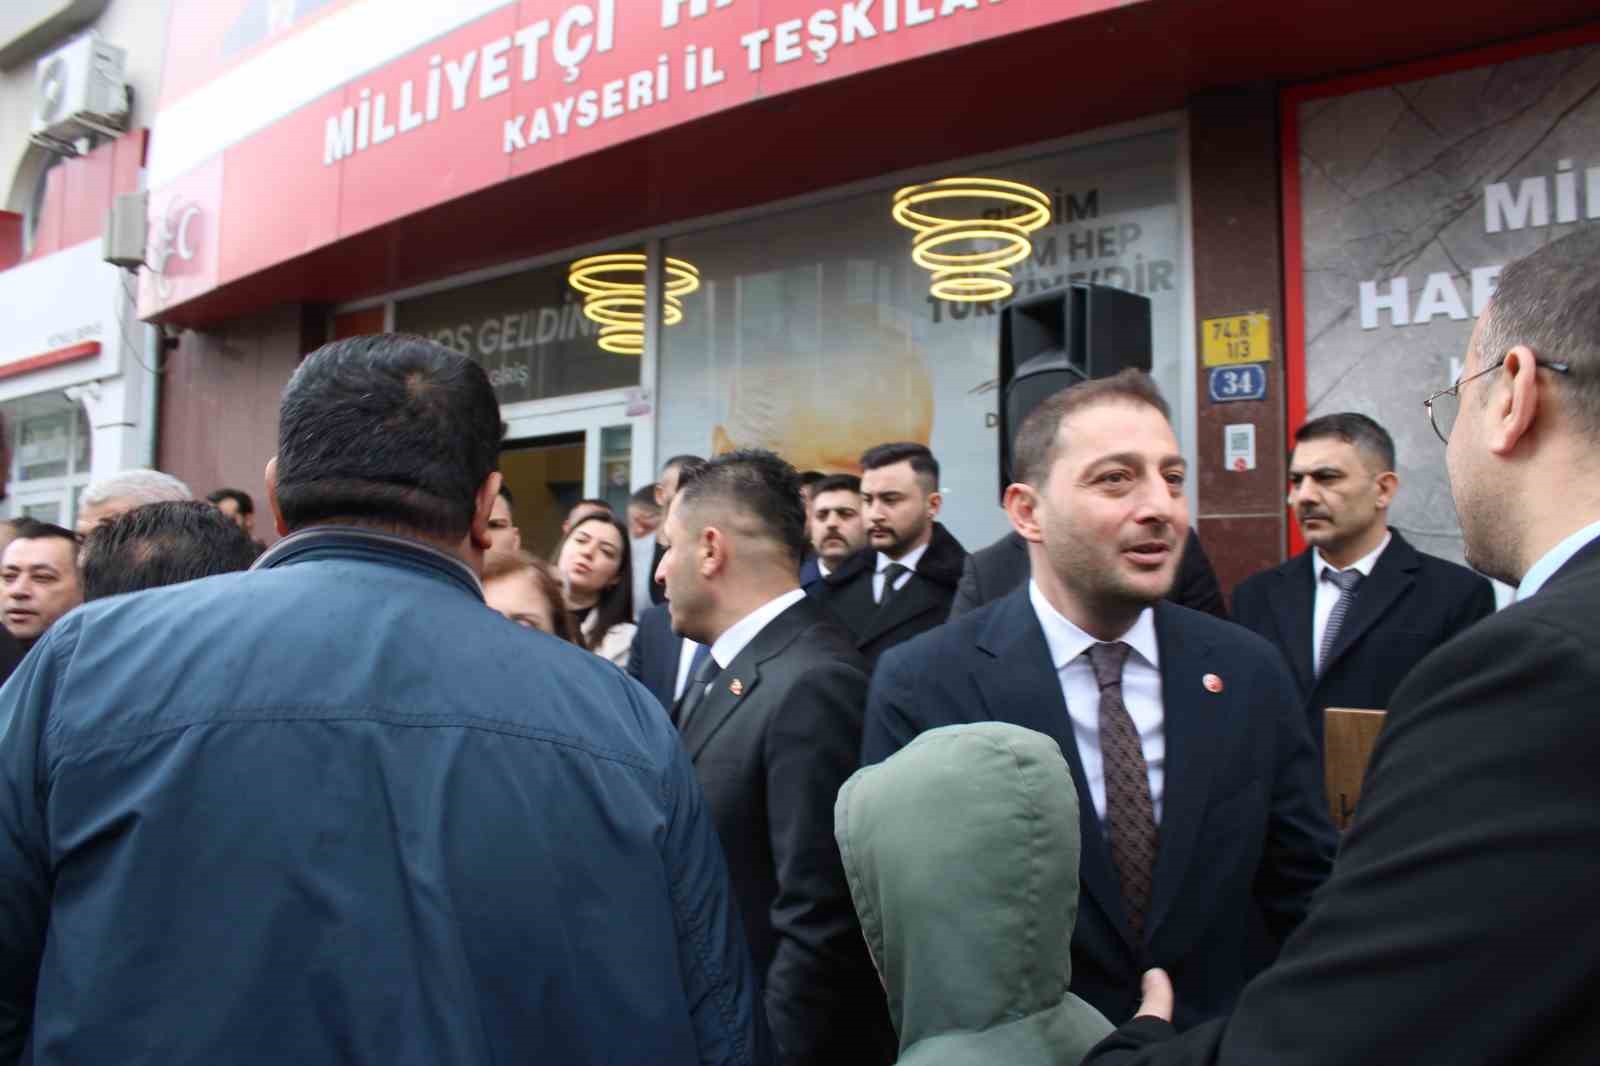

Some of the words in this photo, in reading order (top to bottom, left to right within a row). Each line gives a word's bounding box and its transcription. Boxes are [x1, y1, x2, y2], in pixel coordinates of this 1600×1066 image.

[503, 53, 669, 154] KAYSERİ
[684, 44, 726, 92] İL
[1067, 222, 1143, 263] HEP
[1222, 370, 1253, 395] 34
